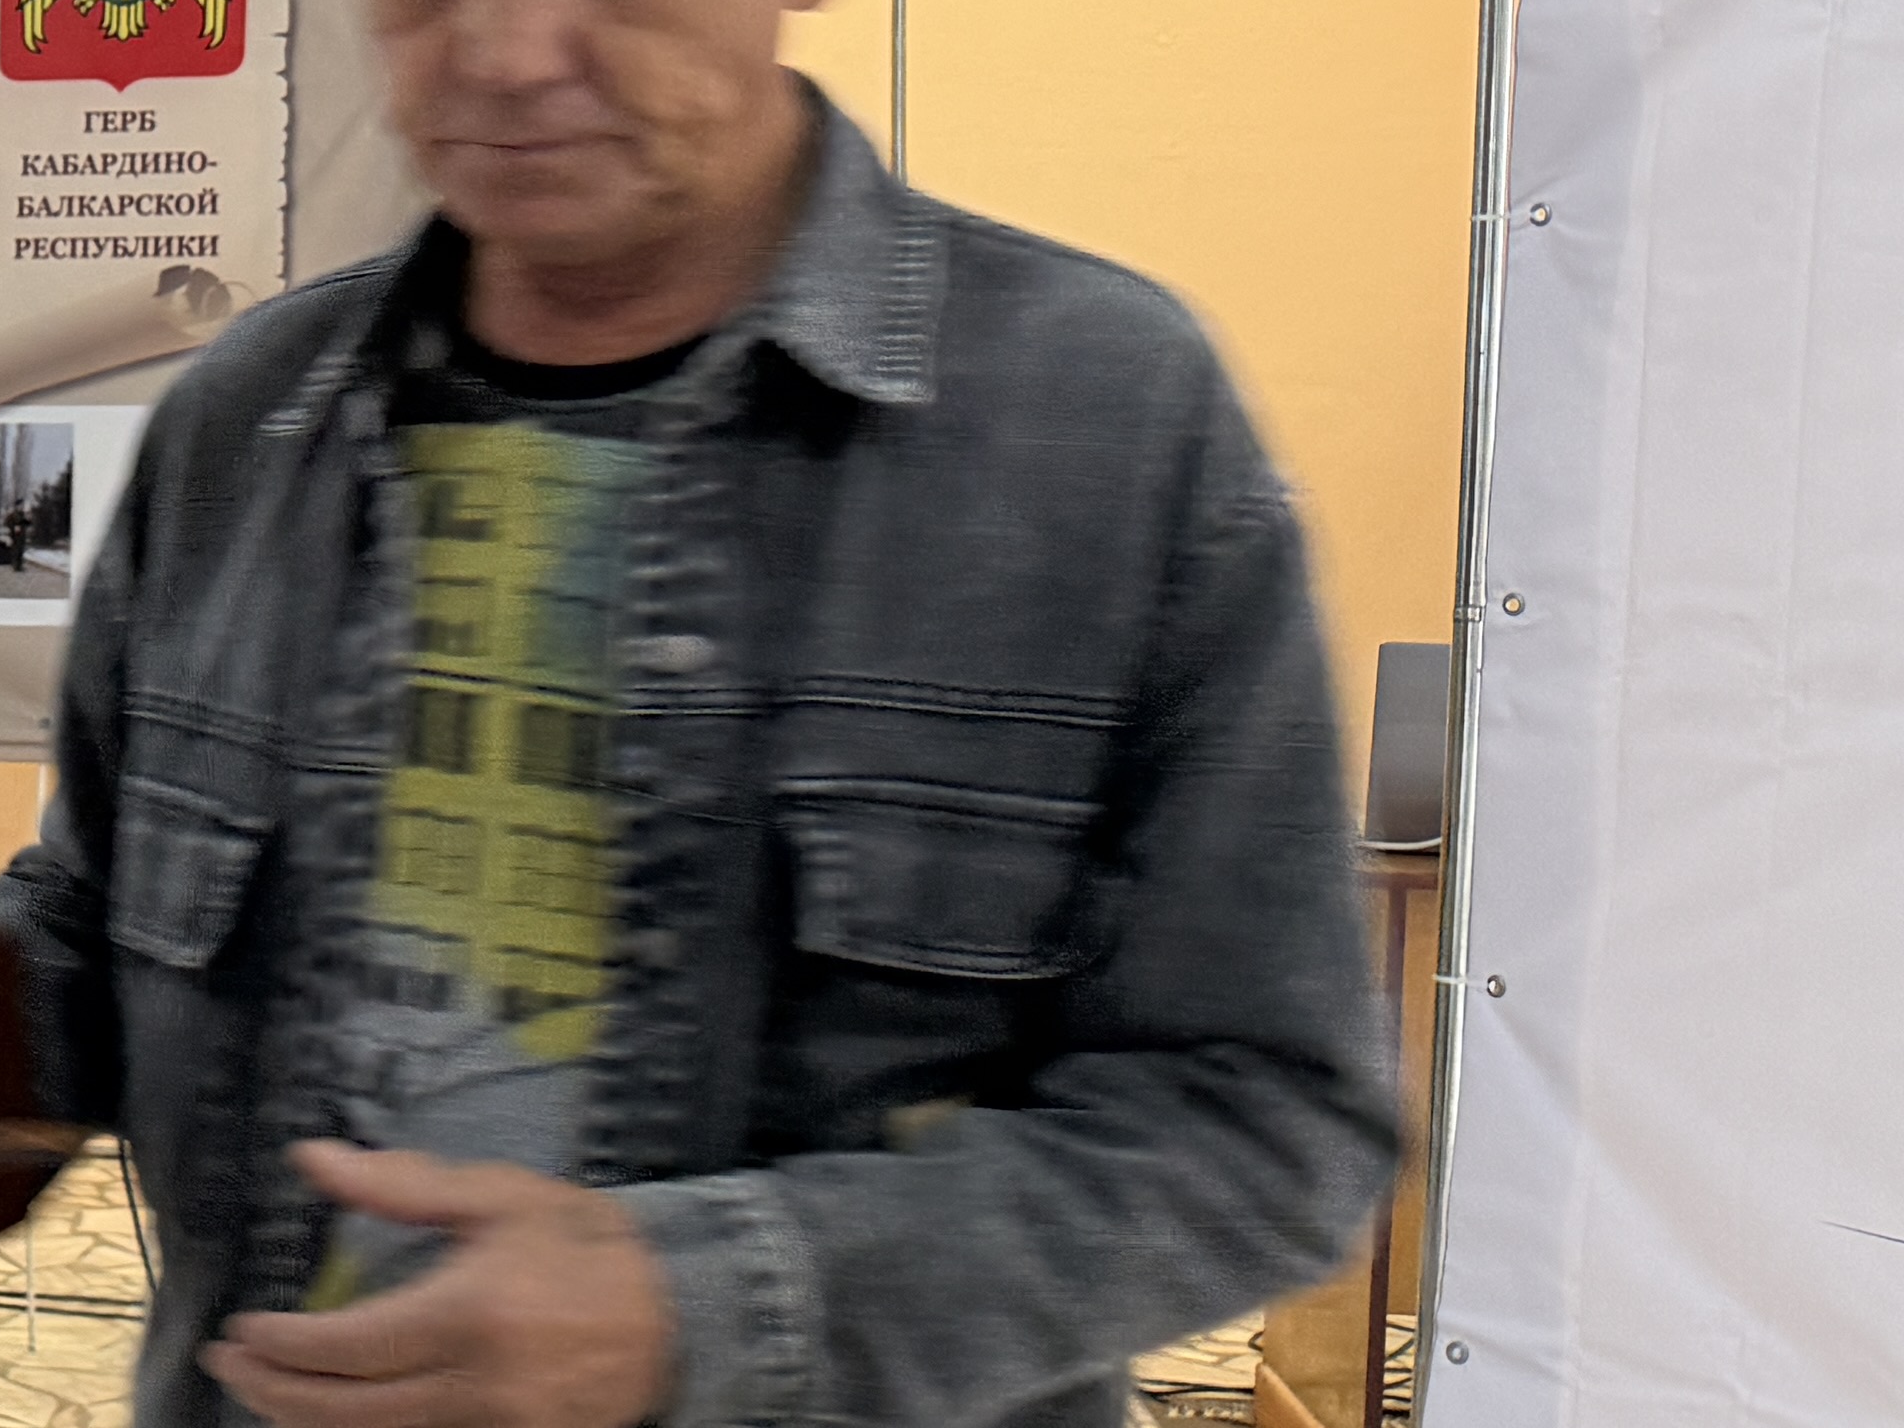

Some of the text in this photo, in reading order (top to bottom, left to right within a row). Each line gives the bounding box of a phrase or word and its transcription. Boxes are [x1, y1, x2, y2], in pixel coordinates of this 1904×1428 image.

[84, 109, 156, 133] ГЕРБ
[21, 150, 218, 178] КАБАРДИНО-
[16, 187, 219, 218] БАЛКАРСКОЙ
[14, 233, 219, 260] РЕСПУБЛИКИ
